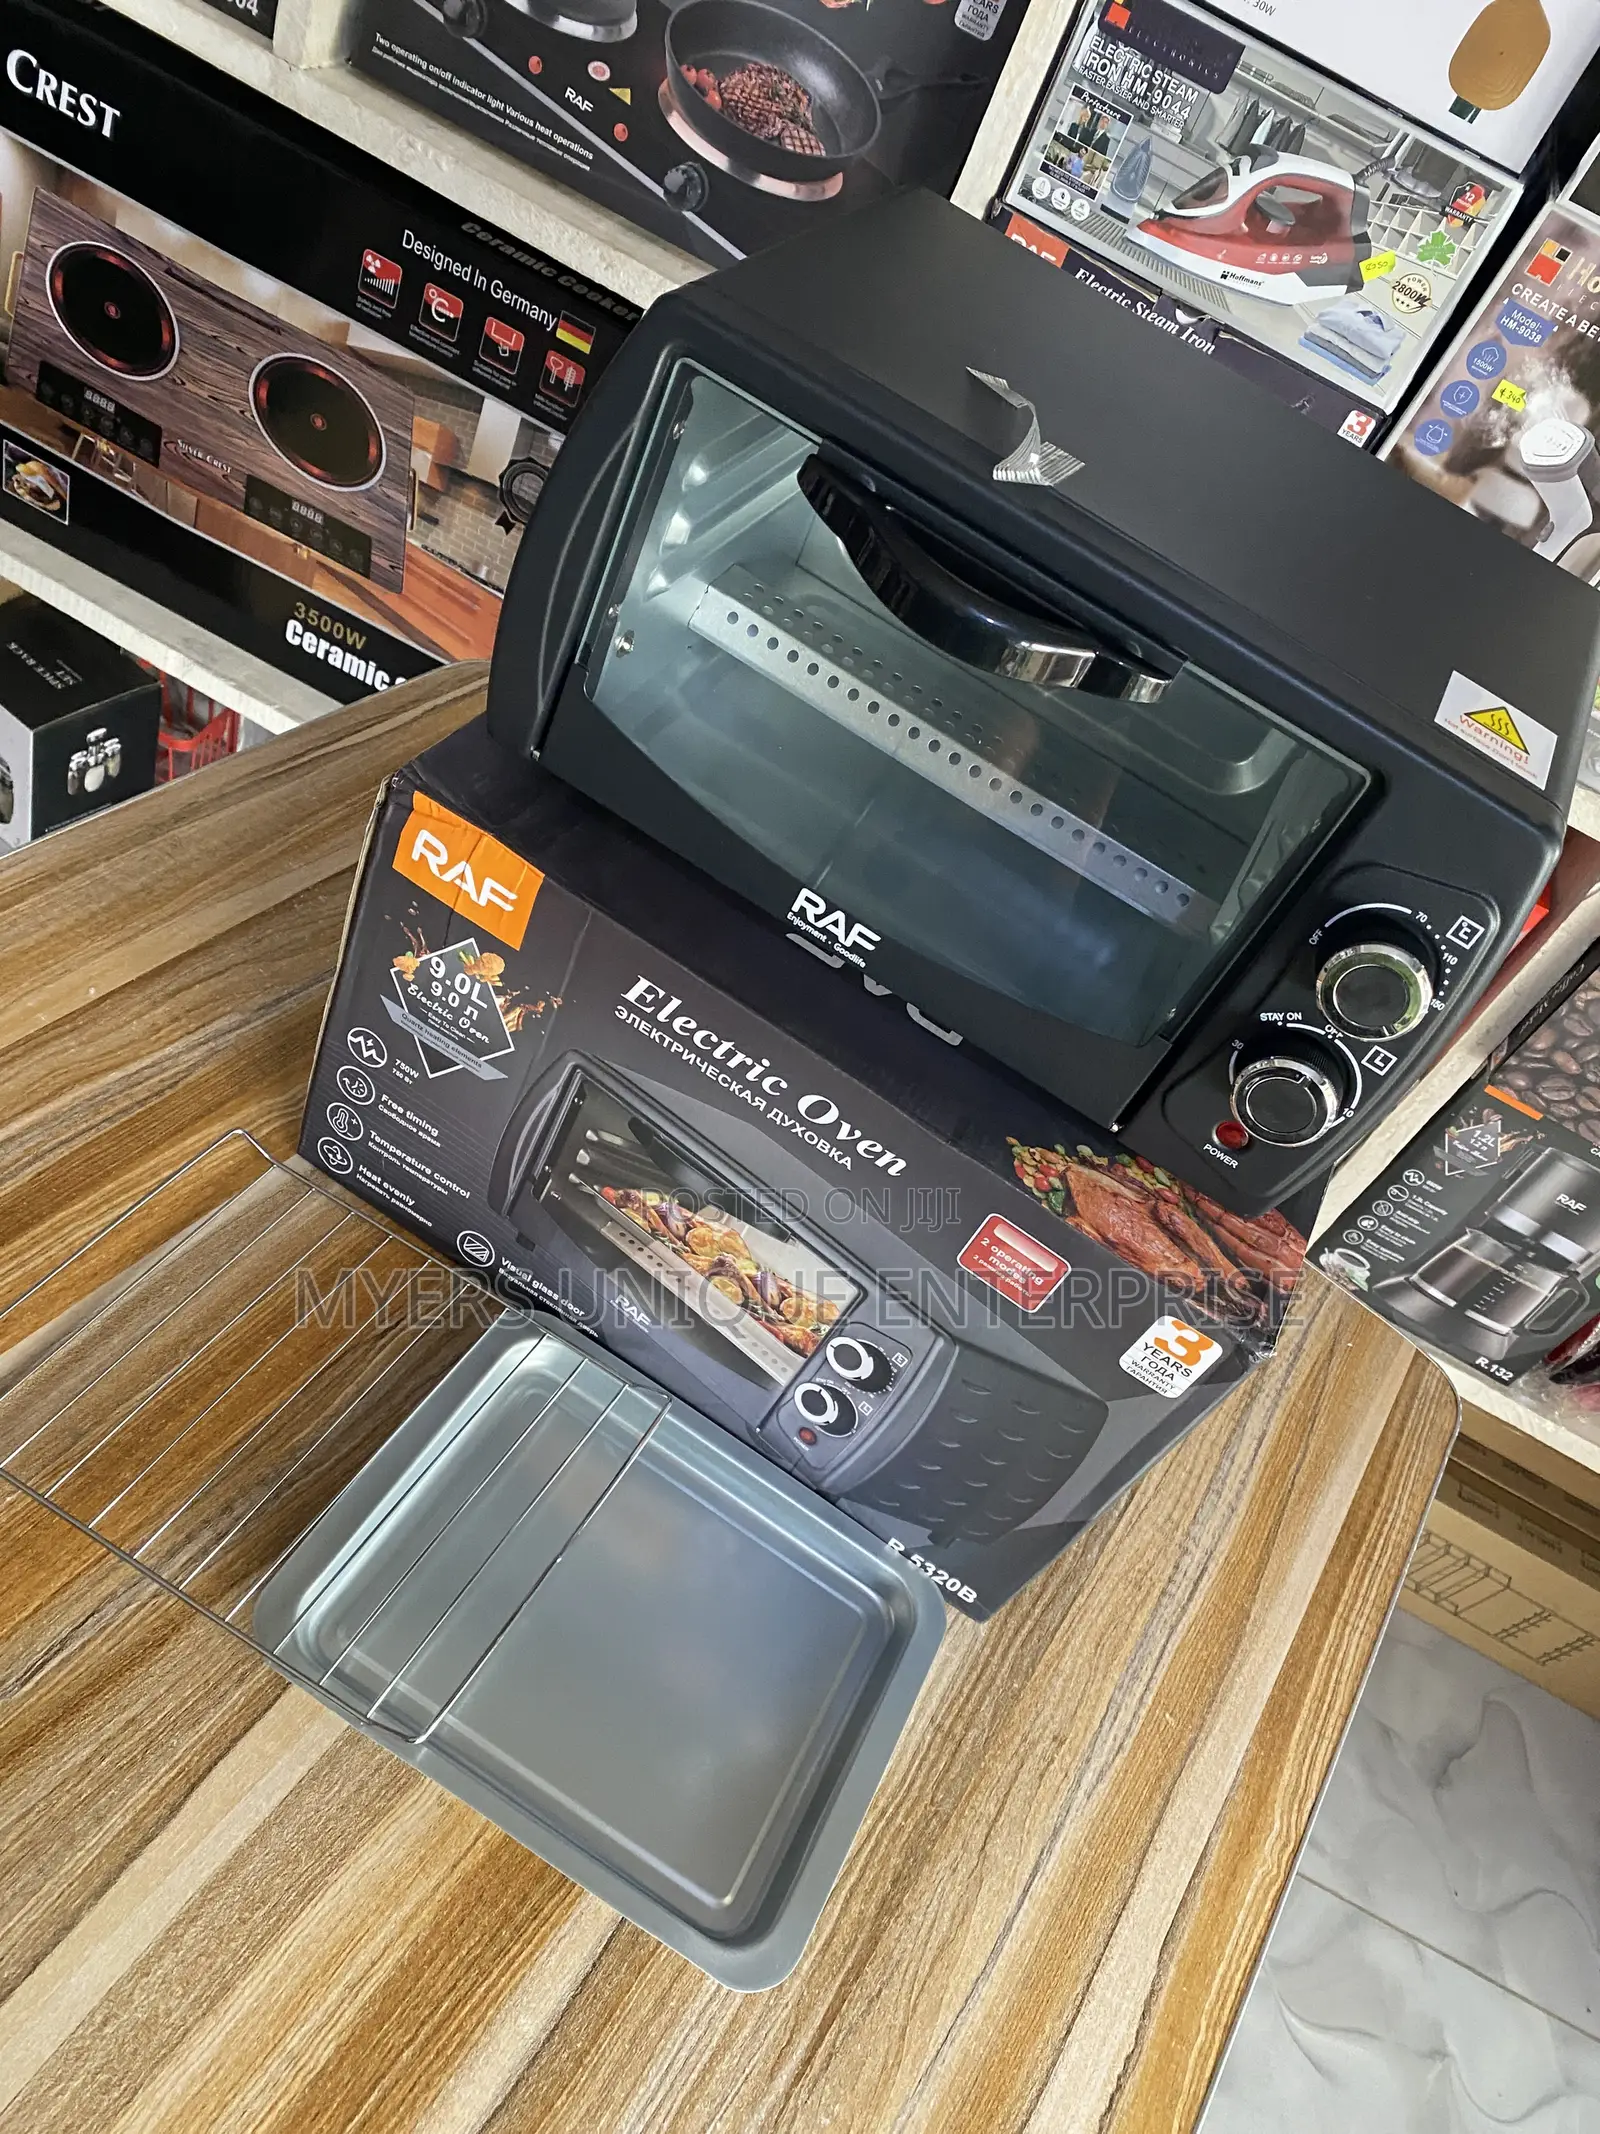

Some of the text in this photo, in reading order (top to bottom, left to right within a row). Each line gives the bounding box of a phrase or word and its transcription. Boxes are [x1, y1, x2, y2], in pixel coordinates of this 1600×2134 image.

[1083, 51, 1192, 120] IRON HM-9044
[1090, 36, 1199, 104] ELECTRIC STEAM
[6, 49, 121, 140] CREST
[375, 32, 390, 47] Two
[391, 44, 427, 70] operating
[428, 63, 453, 81] on/off
[486, 93, 505, 112] light
[505, 102, 535, 127] Various
[535, 120, 552, 138] heat
[552, 134, 594, 160] operations
[564, 87, 594, 114] RAF
[1133, 94, 1150, 110] AND
[1150, 105, 1185, 130] SMARTER
[1445, 207, 1473, 223] WARRANTY
[1465, 192, 1475, 202] 12
[461, 221, 556, 277] Ceramic
[402, 229, 558, 332] Designed In Germany
[1229, 272, 1263, 287] Hoffmans
[1407, 277, 1427, 292] POWER
[1075, 267, 1216, 355] Electric Steam Iron
[1511, 283, 1600, 342] CREATE A BE
[1511, 309, 1543, 333] Model:
[1500, 316, 1543, 344] HM-9038
[1472, 357, 1495, 373] 1500W
[1342, 430, 1363, 444] YEARS
[1347, 410, 1373, 437] 3
[293, 602, 367, 651] 3500W
[285, 618, 388, 691] Ceramic
[1459, 715, 1529, 765] Warning!
[411, 829, 518, 911] RAF
[791, 887, 881, 951] RAF
[1415, 912, 1427, 923] 70
[786, 912, 866, 969] Enjoyment Goodlife
[1308, 929, 1323, 946] OFF
[1442, 952, 1458, 965] 110
[430, 957, 488, 1009] 9.0L
[431, 981, 460, 1008] 9.0
[407, 982, 454, 1021] Electric
[458, 1015, 490, 1044] Oven
[1260, 1011, 1302, 1021] STAY ON
[1431, 997, 1445, 1011] 150
[401, 1012, 424, 1033] Quartz
[423, 1026, 451, 1051] heating
[449, 1042, 483, 1070] elements
[1231, 1039, 1244, 1050] 30
[394, 1058, 419, 1079] 750W
[620, 974, 788, 1097] Electric
[796, 1094, 908, 1178] Oven
[614, 1005, 852, 1172] ЭЛЕКТРИЧЕСКАЯ ДУХОВКА
[378, 1104, 441, 1148] Свободное время
[381, 1094, 439, 1137] Free timing
[1343, 1108, 1355, 1118] 10
[1203, 1143, 1239, 1169] POWER
[1473, 1130, 1496, 1147] 1.2L
[368, 1141, 448, 1196] Контроль температуры
[369, 1130, 471, 1199] Temperature control
[356, 1174, 433, 1228] Нагревать равномерно
[358, 1164, 415, 1207] Heat evenly
[1556, 1193, 1587, 1211] RAF
[980, 1237, 1044, 1286] 2 operating
[988, 1254, 1027, 1284] modes
[501, 1256, 531, 1283] Visual
[532, 1278, 560, 1302] glass
[561, 1296, 586, 1318] door
[614, 1293, 652, 1326] RAF
[1143, 1342, 1193, 1378] YEARS
[1153, 1319, 1214, 1366] 3
[1126, 1365, 1168, 1395] ГАРАНТИЯ
[1131, 1359, 1175, 1391] WARRANTY
[1141, 1355, 1175, 1382] ГОДА
[1475, 1356, 1514, 1383] R.132
